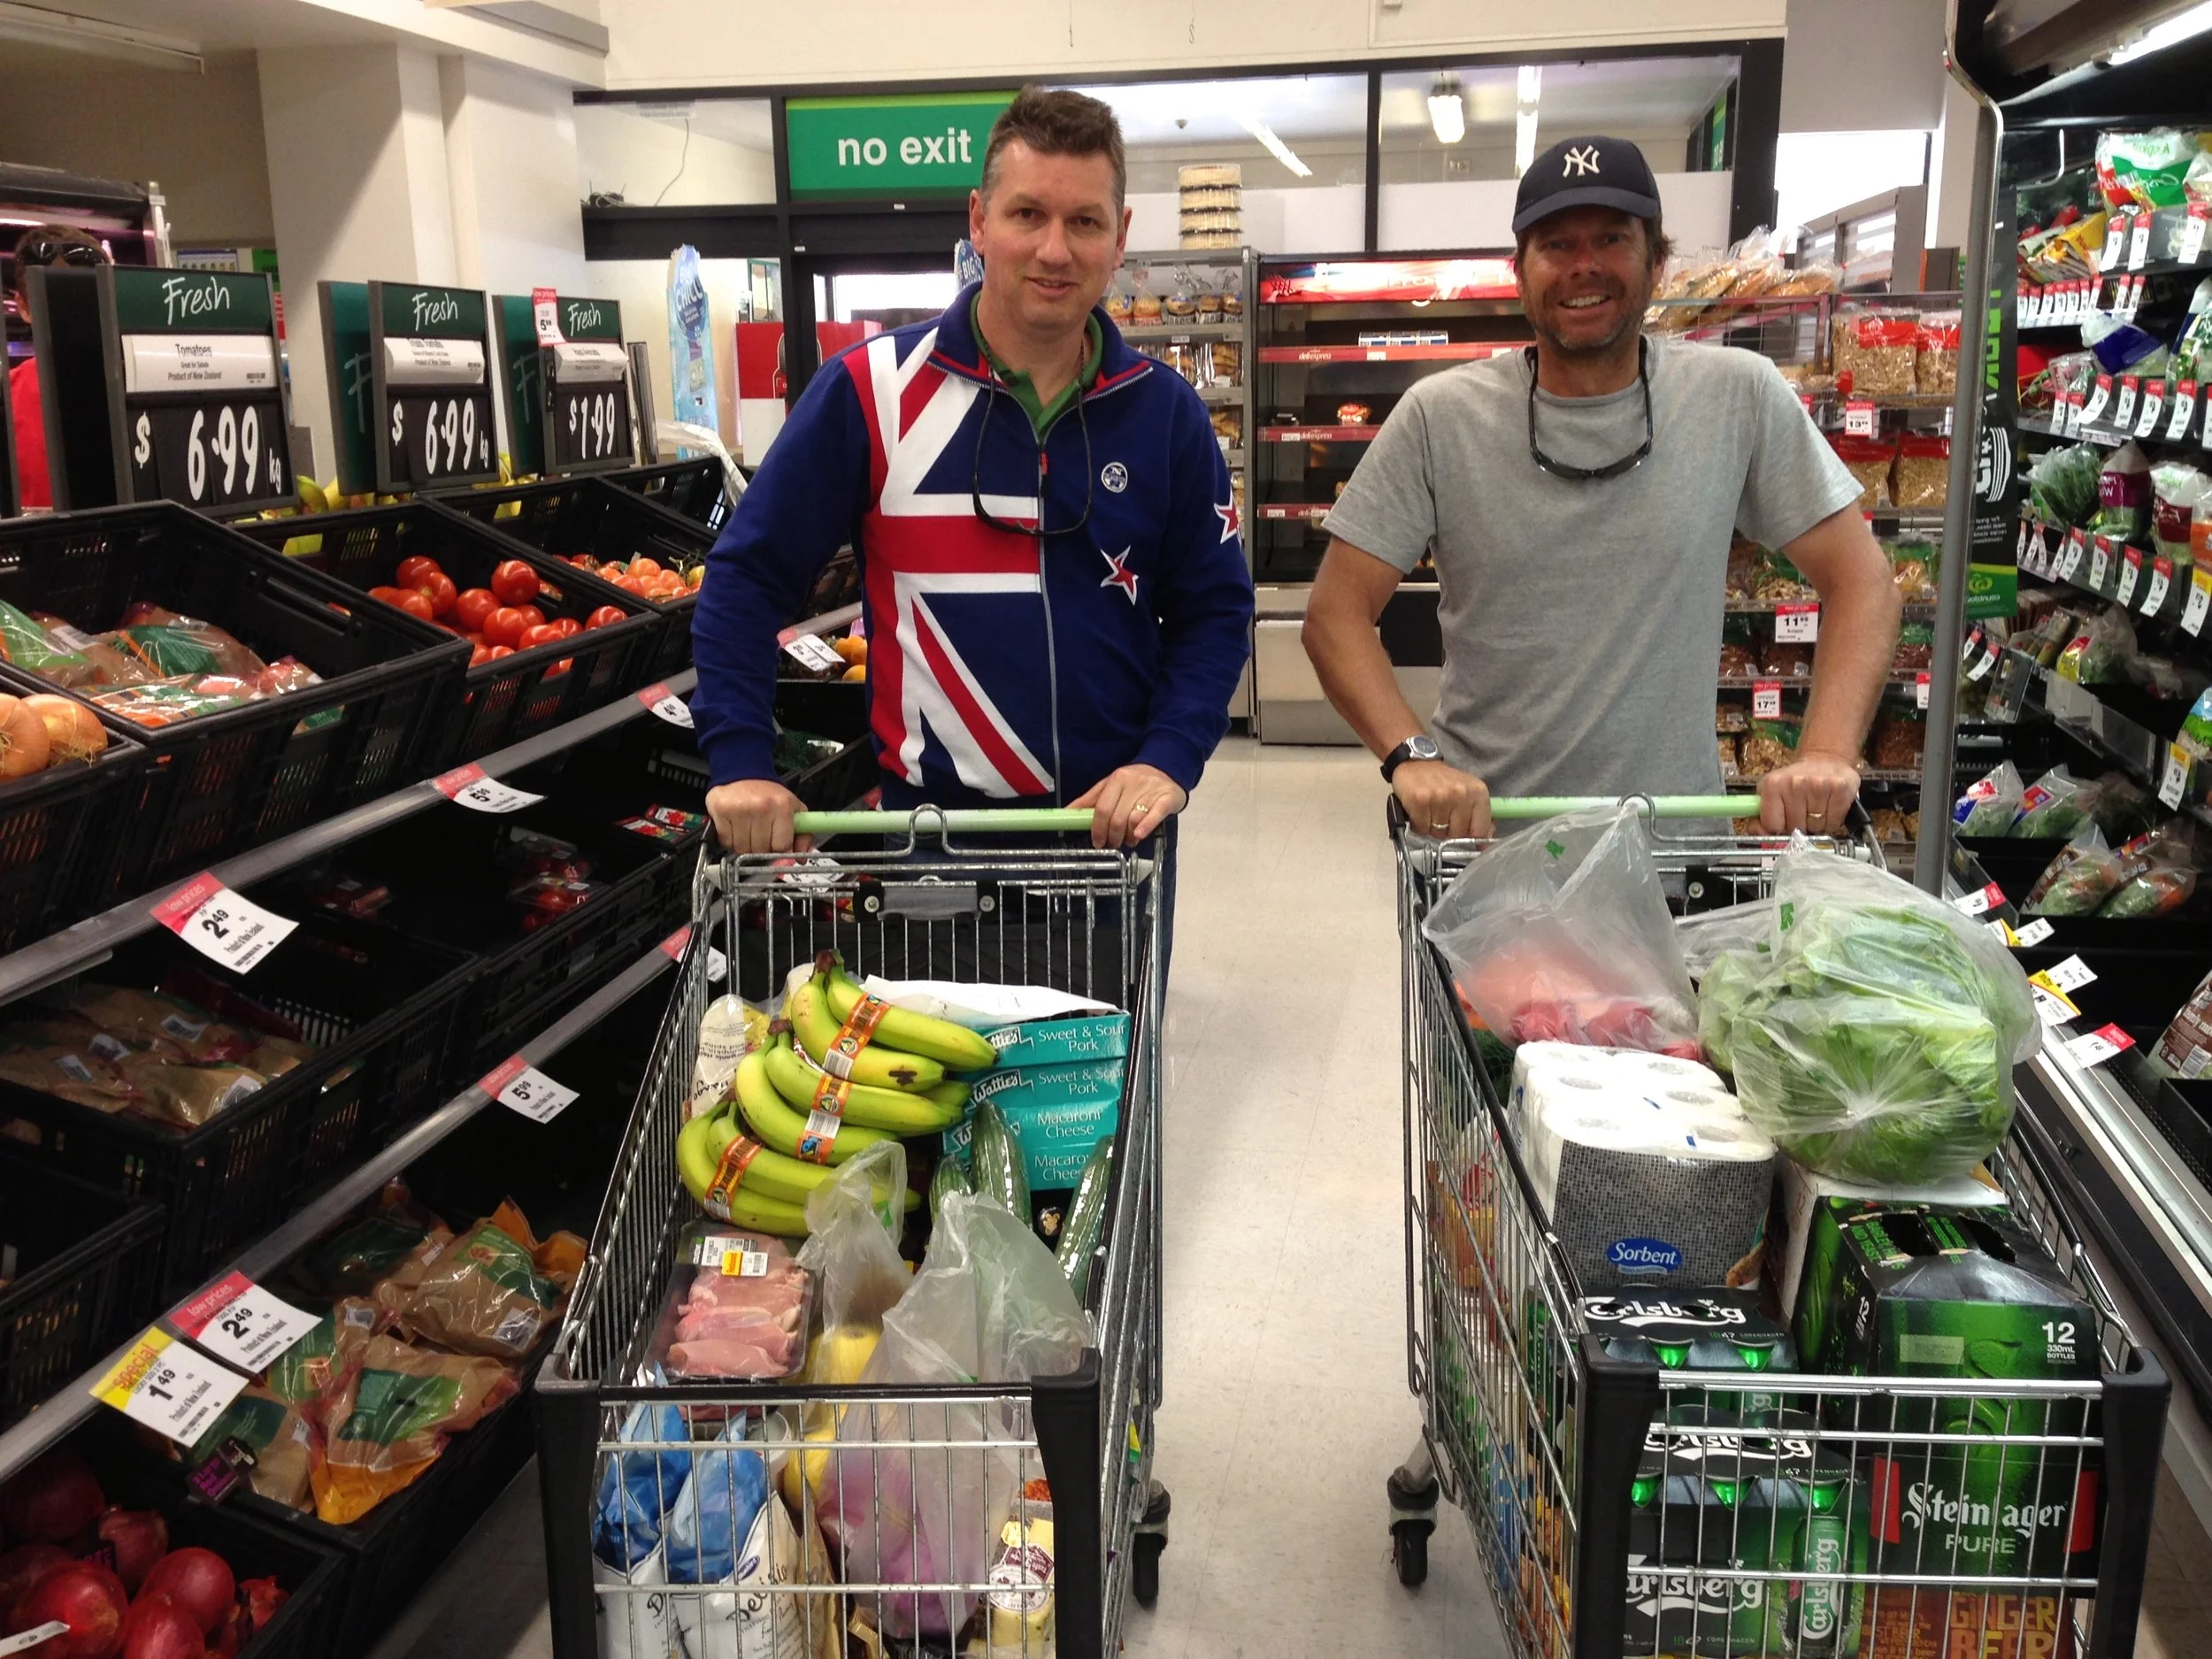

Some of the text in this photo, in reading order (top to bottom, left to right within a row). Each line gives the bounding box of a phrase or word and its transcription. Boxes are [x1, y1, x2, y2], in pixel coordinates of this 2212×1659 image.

[838, 127, 972, 165] no exit
[1563, 145, 1601, 177] NY
[162, 276, 230, 326] Fresh
[411, 292, 458, 332] Fresh
[567, 302, 602, 336] Fresh
[175, 343, 212, 357] Tomatoes
[168, 370, 222, 380] Product of New Zealand
[269, 447, 281, 495] kg
[990, 1028, 1018, 1049] ttie's
[1038, 1025, 1126, 1042] Sweet & Sour
[1069, 1038, 1099, 1053] Pork
[974, 1071, 1018, 1103] Wattie's
[1039, 1068, 1125, 1086] Sweet & Sour
[1069, 1081, 1099, 1096] Pork
[1037, 1110, 1102, 1126] Macaroni
[1046, 1123, 1095, 1139] Cheese
[1034, 1154, 1090, 1169] Macaro
[1611, 1242, 1678, 1265] Sorbent
[186, 1301, 204, 1317] low
[203, 1283, 234, 1310] prices
[2042, 1321, 2076, 1344] 12
[2047, 1343, 2077, 1354] 330mL
[112, 1341, 160, 1392] special
[1946, 1533, 2016, 1555] PURE
[1801, 1538, 1843, 1640] Carlserg
[1951, 1592, 2057, 1631] GINGER
